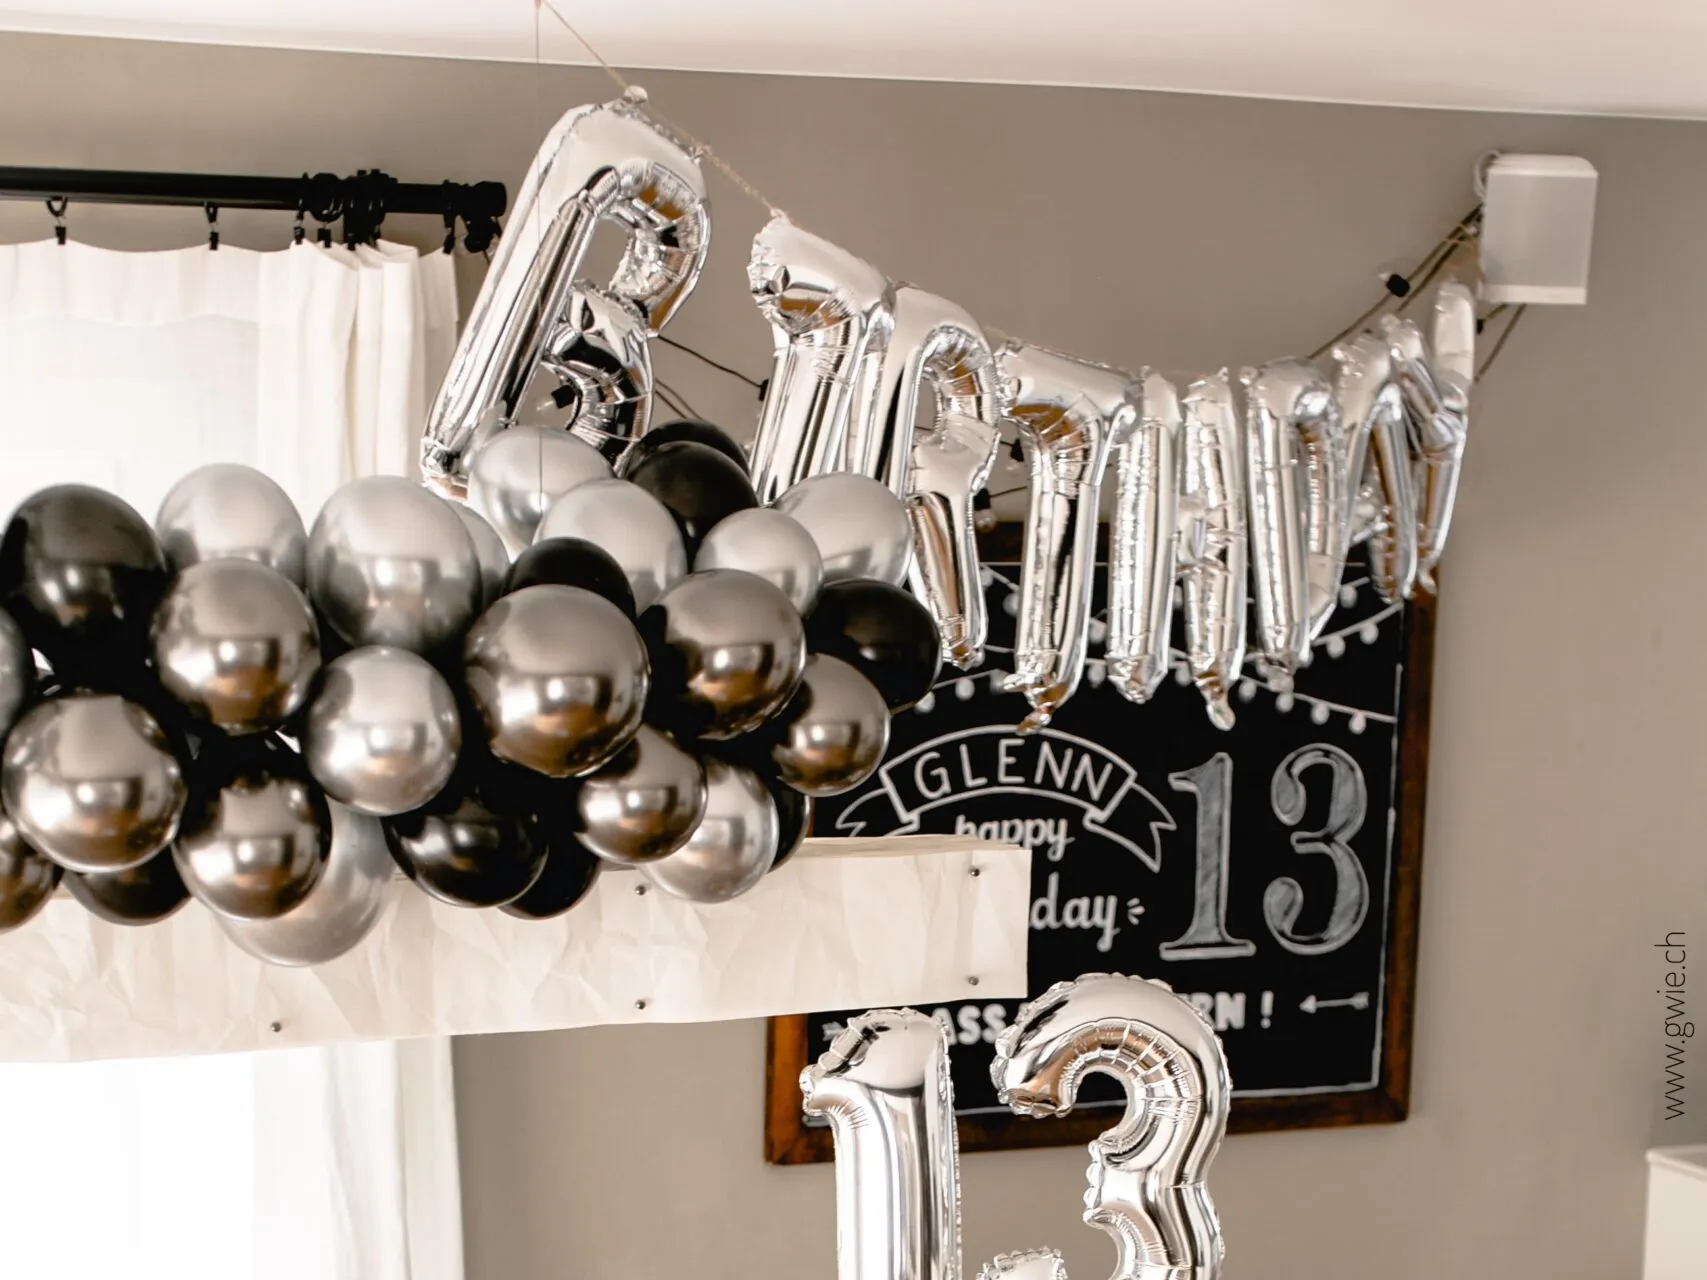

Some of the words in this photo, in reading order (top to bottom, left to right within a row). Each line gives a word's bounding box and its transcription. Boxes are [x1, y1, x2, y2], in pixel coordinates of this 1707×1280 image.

[914, 738, 1113, 801] GLENN
[1160, 742, 1370, 960] 13
[1030, 871, 1121, 952] day
